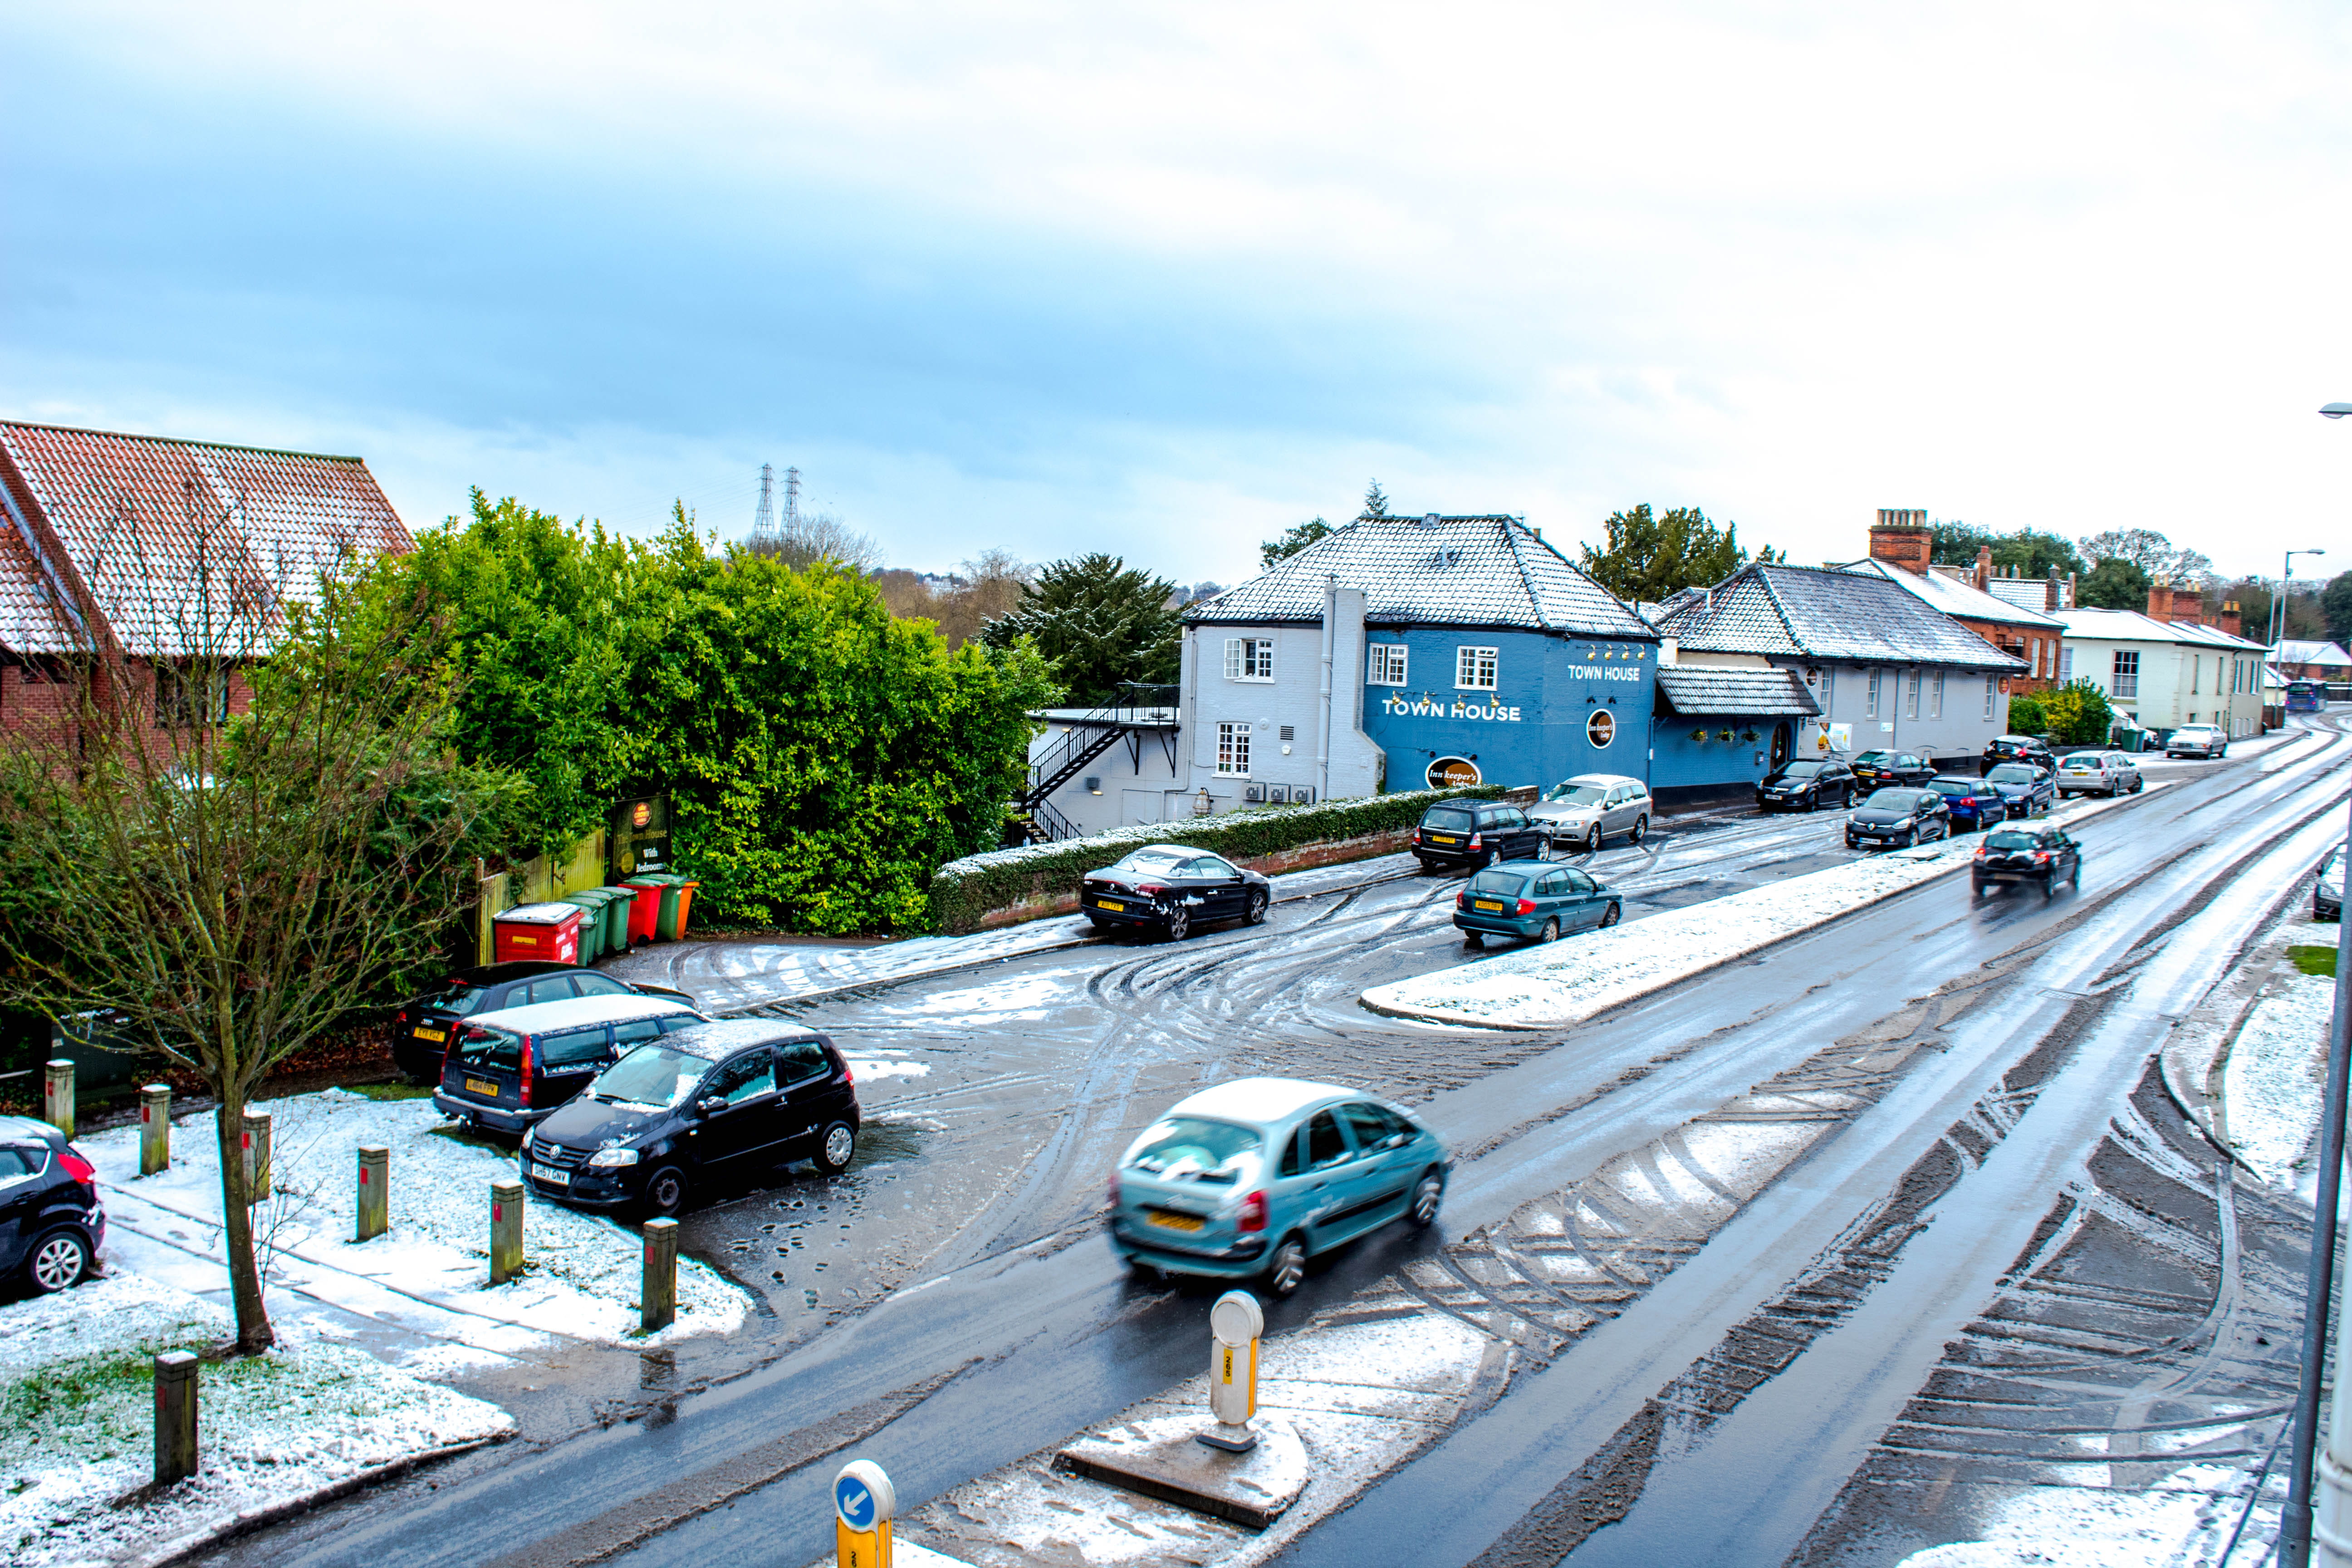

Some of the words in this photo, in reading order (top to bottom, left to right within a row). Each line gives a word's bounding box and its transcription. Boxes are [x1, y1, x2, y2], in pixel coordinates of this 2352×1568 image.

[1568, 665, 1602, 680] TOWN
[1604, 666, 1641, 681] HOUSE
[1382, 700, 1445, 717] TOWN
[1450, 704, 1521, 721] HOUSE
[1429, 769, 1443, 778] Inn
[1444, 770, 1477, 781] keeper's
[645, 829, 667, 839] House
[643, 848, 658, 858] With
[535, 1166, 551, 1178] SH57
[552, 1169, 566, 1181] GNV
